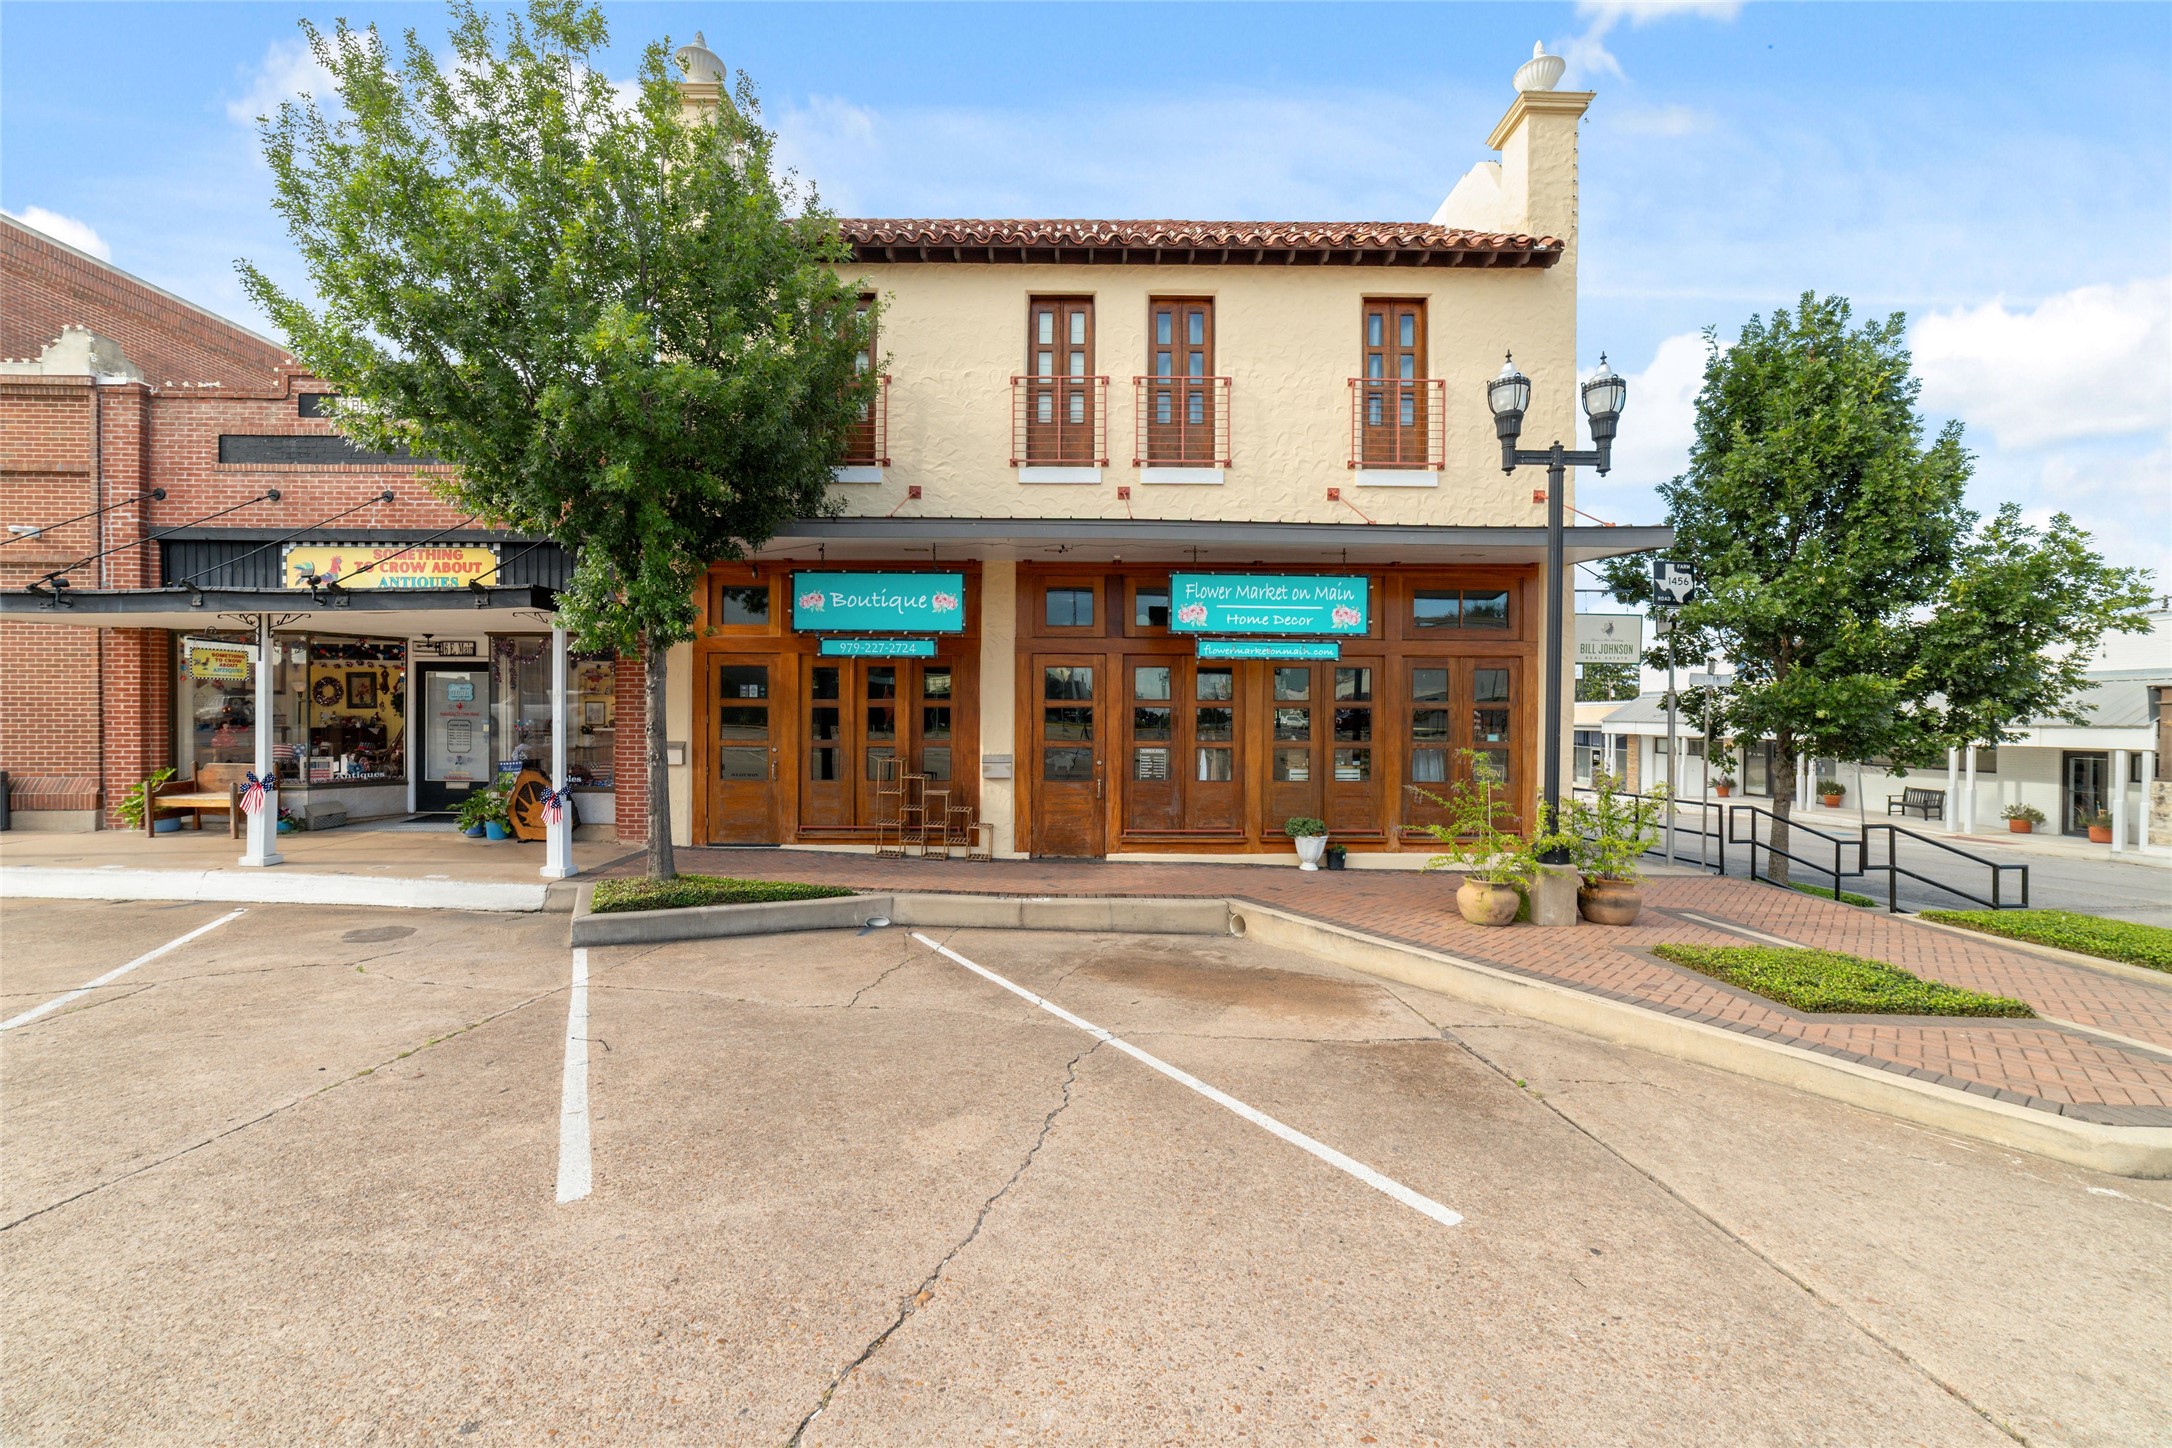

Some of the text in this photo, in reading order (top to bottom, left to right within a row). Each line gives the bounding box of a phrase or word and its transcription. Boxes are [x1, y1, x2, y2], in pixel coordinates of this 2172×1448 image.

[373, 549, 464, 560] SOMETHING
[354, 561, 482, 573] TO CROW ABOUT
[378, 577, 459, 588] ANTIQUES
[1668, 577, 1689, 586] 1456
[1185, 582, 1355, 601] Flower Market on Main
[829, 588, 928, 614] Boutique
[1226, 614, 1314, 626] Home Decor
[839, 643, 917, 653] 979-227-2724
[1203, 644, 1334, 656] flowermarketonmain.com
[1580, 643, 1634, 655] BILL JOHNSON
[335, 772, 385, 780] Antiques
